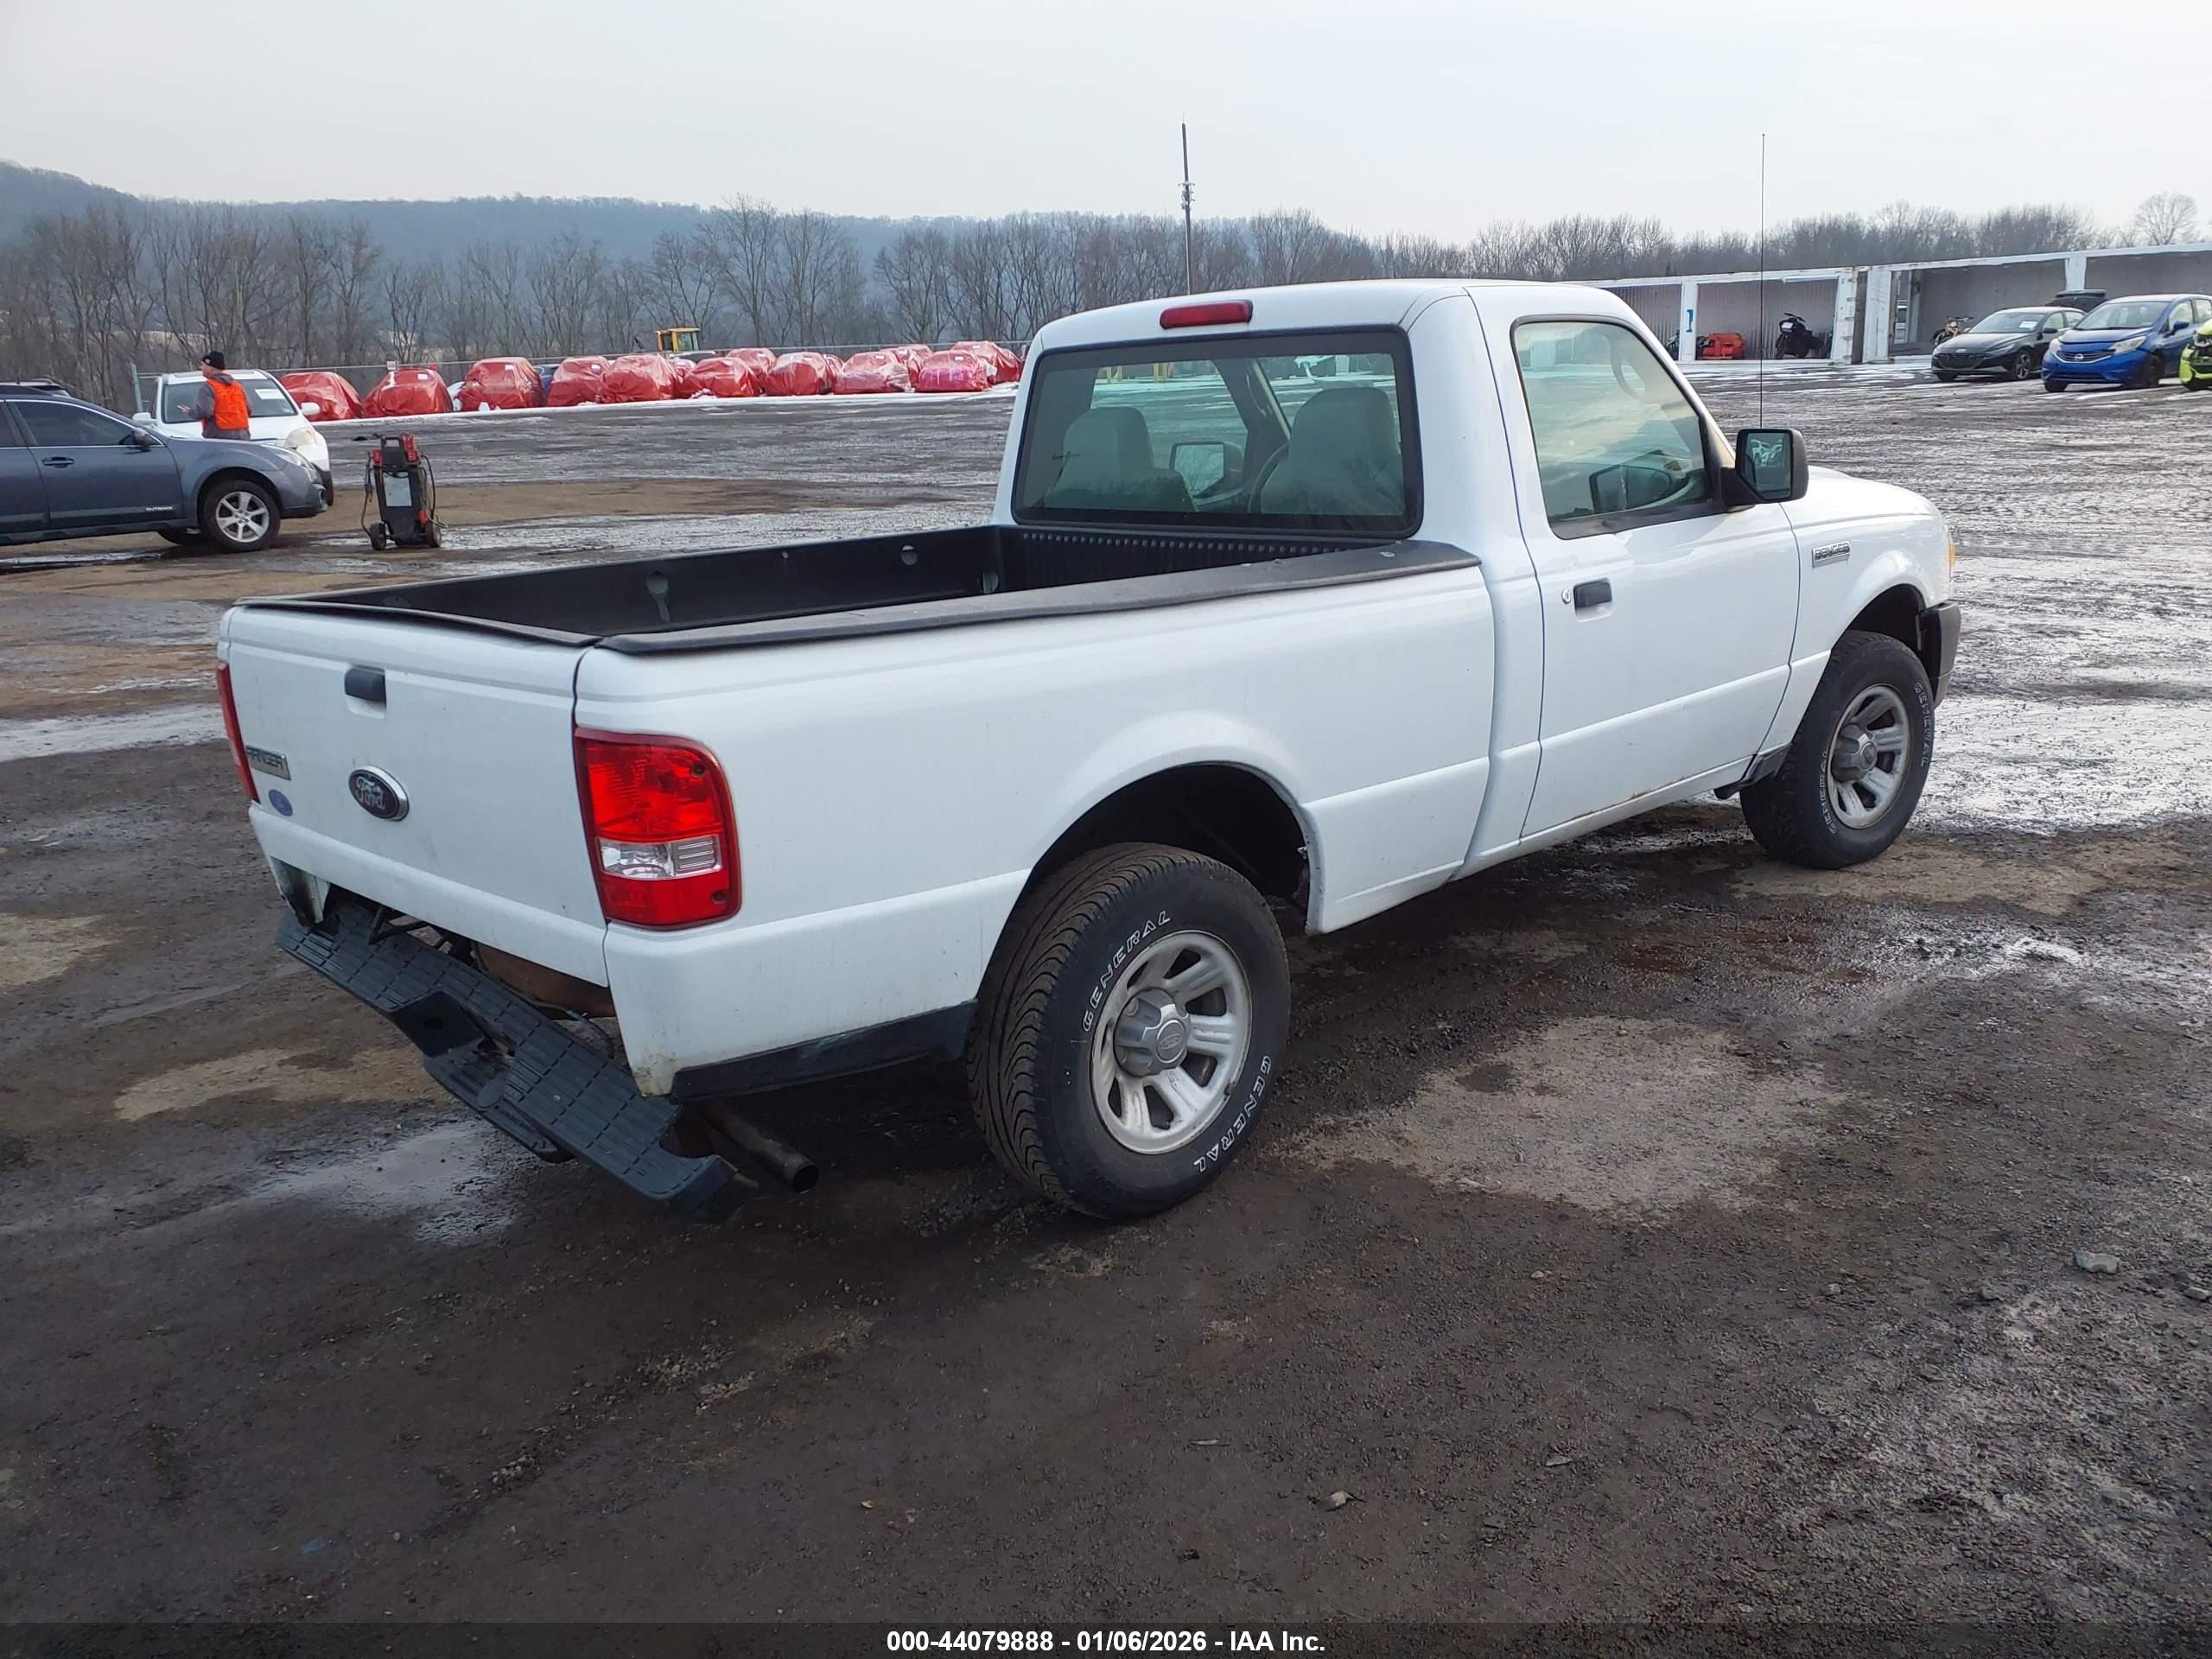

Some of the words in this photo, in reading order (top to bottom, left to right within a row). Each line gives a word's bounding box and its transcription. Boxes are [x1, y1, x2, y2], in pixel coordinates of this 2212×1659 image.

[1814, 542, 1850, 561] RANGER
[1914, 682, 1932, 768] GENERAL
[1082, 910, 1171, 1032] GENERAL
[1193, 1055, 1272, 1173] GENERAL
